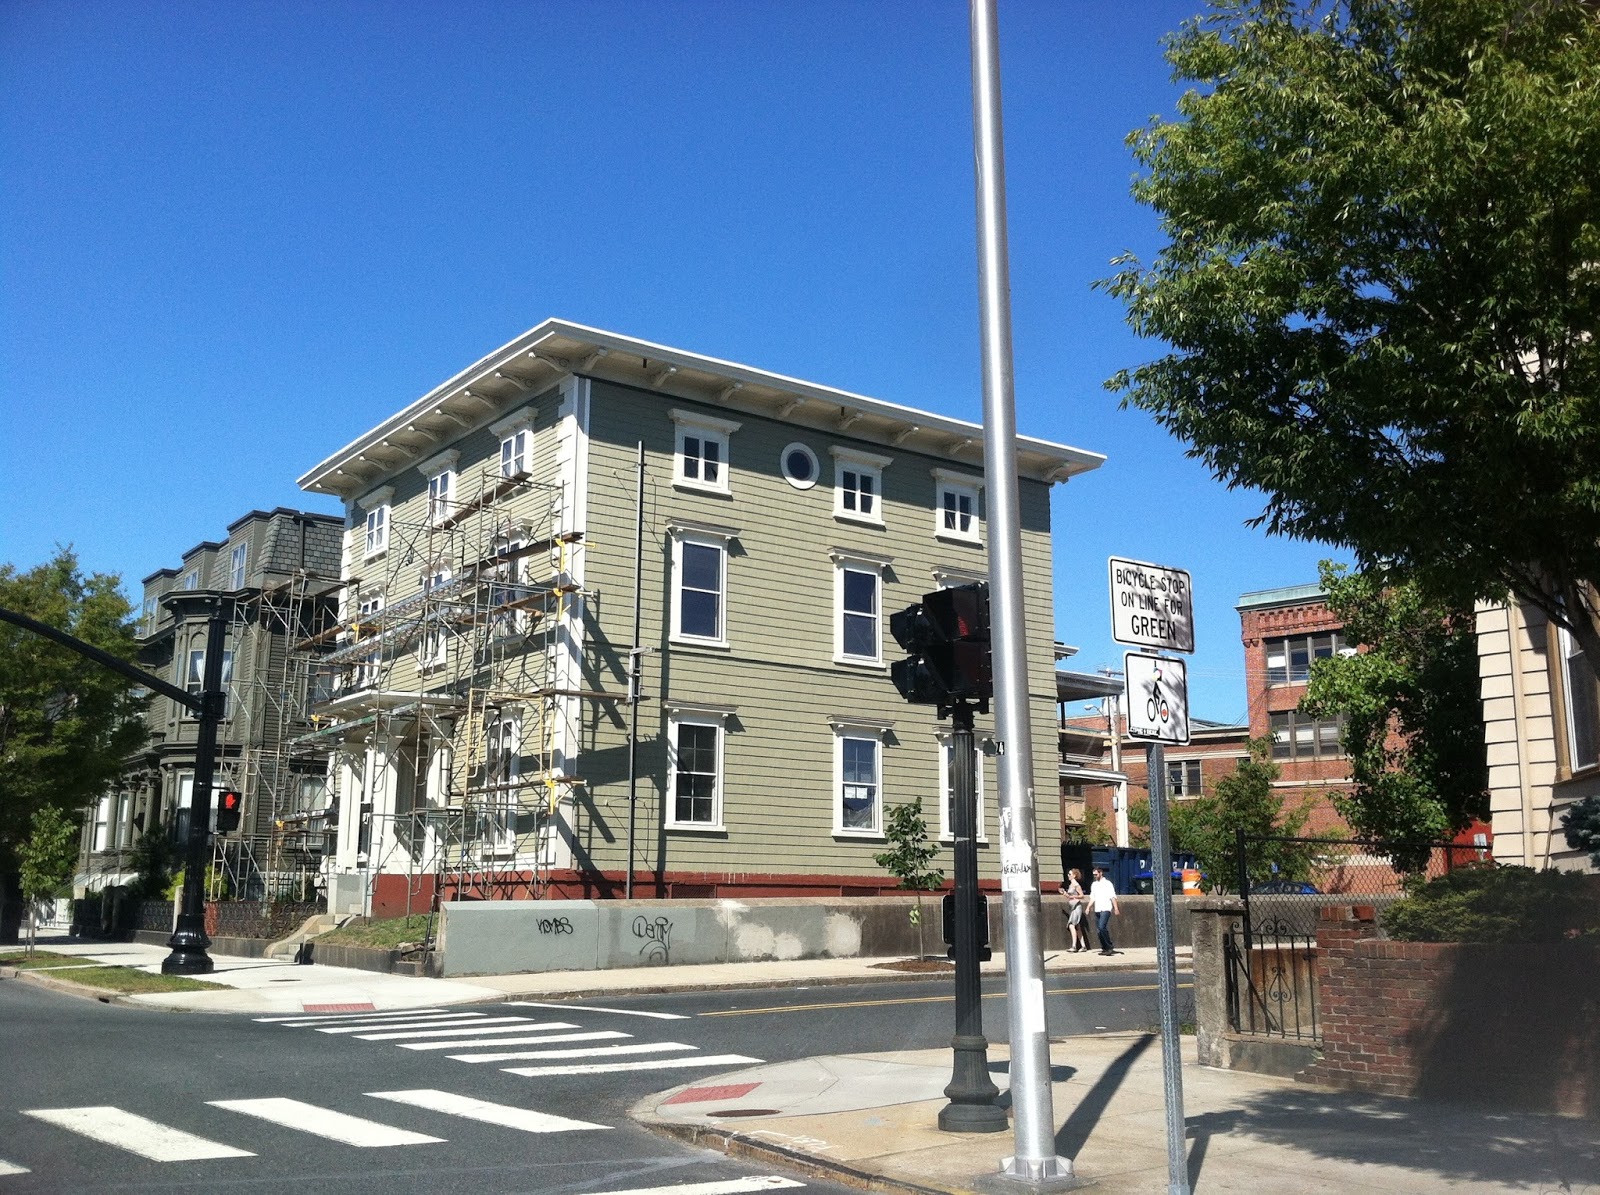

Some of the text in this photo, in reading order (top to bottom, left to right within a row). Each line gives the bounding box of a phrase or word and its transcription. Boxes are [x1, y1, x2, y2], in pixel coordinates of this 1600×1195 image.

[1116, 569, 1185, 594] BICYCLE STOP
[1121, 591, 1183, 616] ON LINE FOR
[1131, 614, 1176, 641] GREEN
